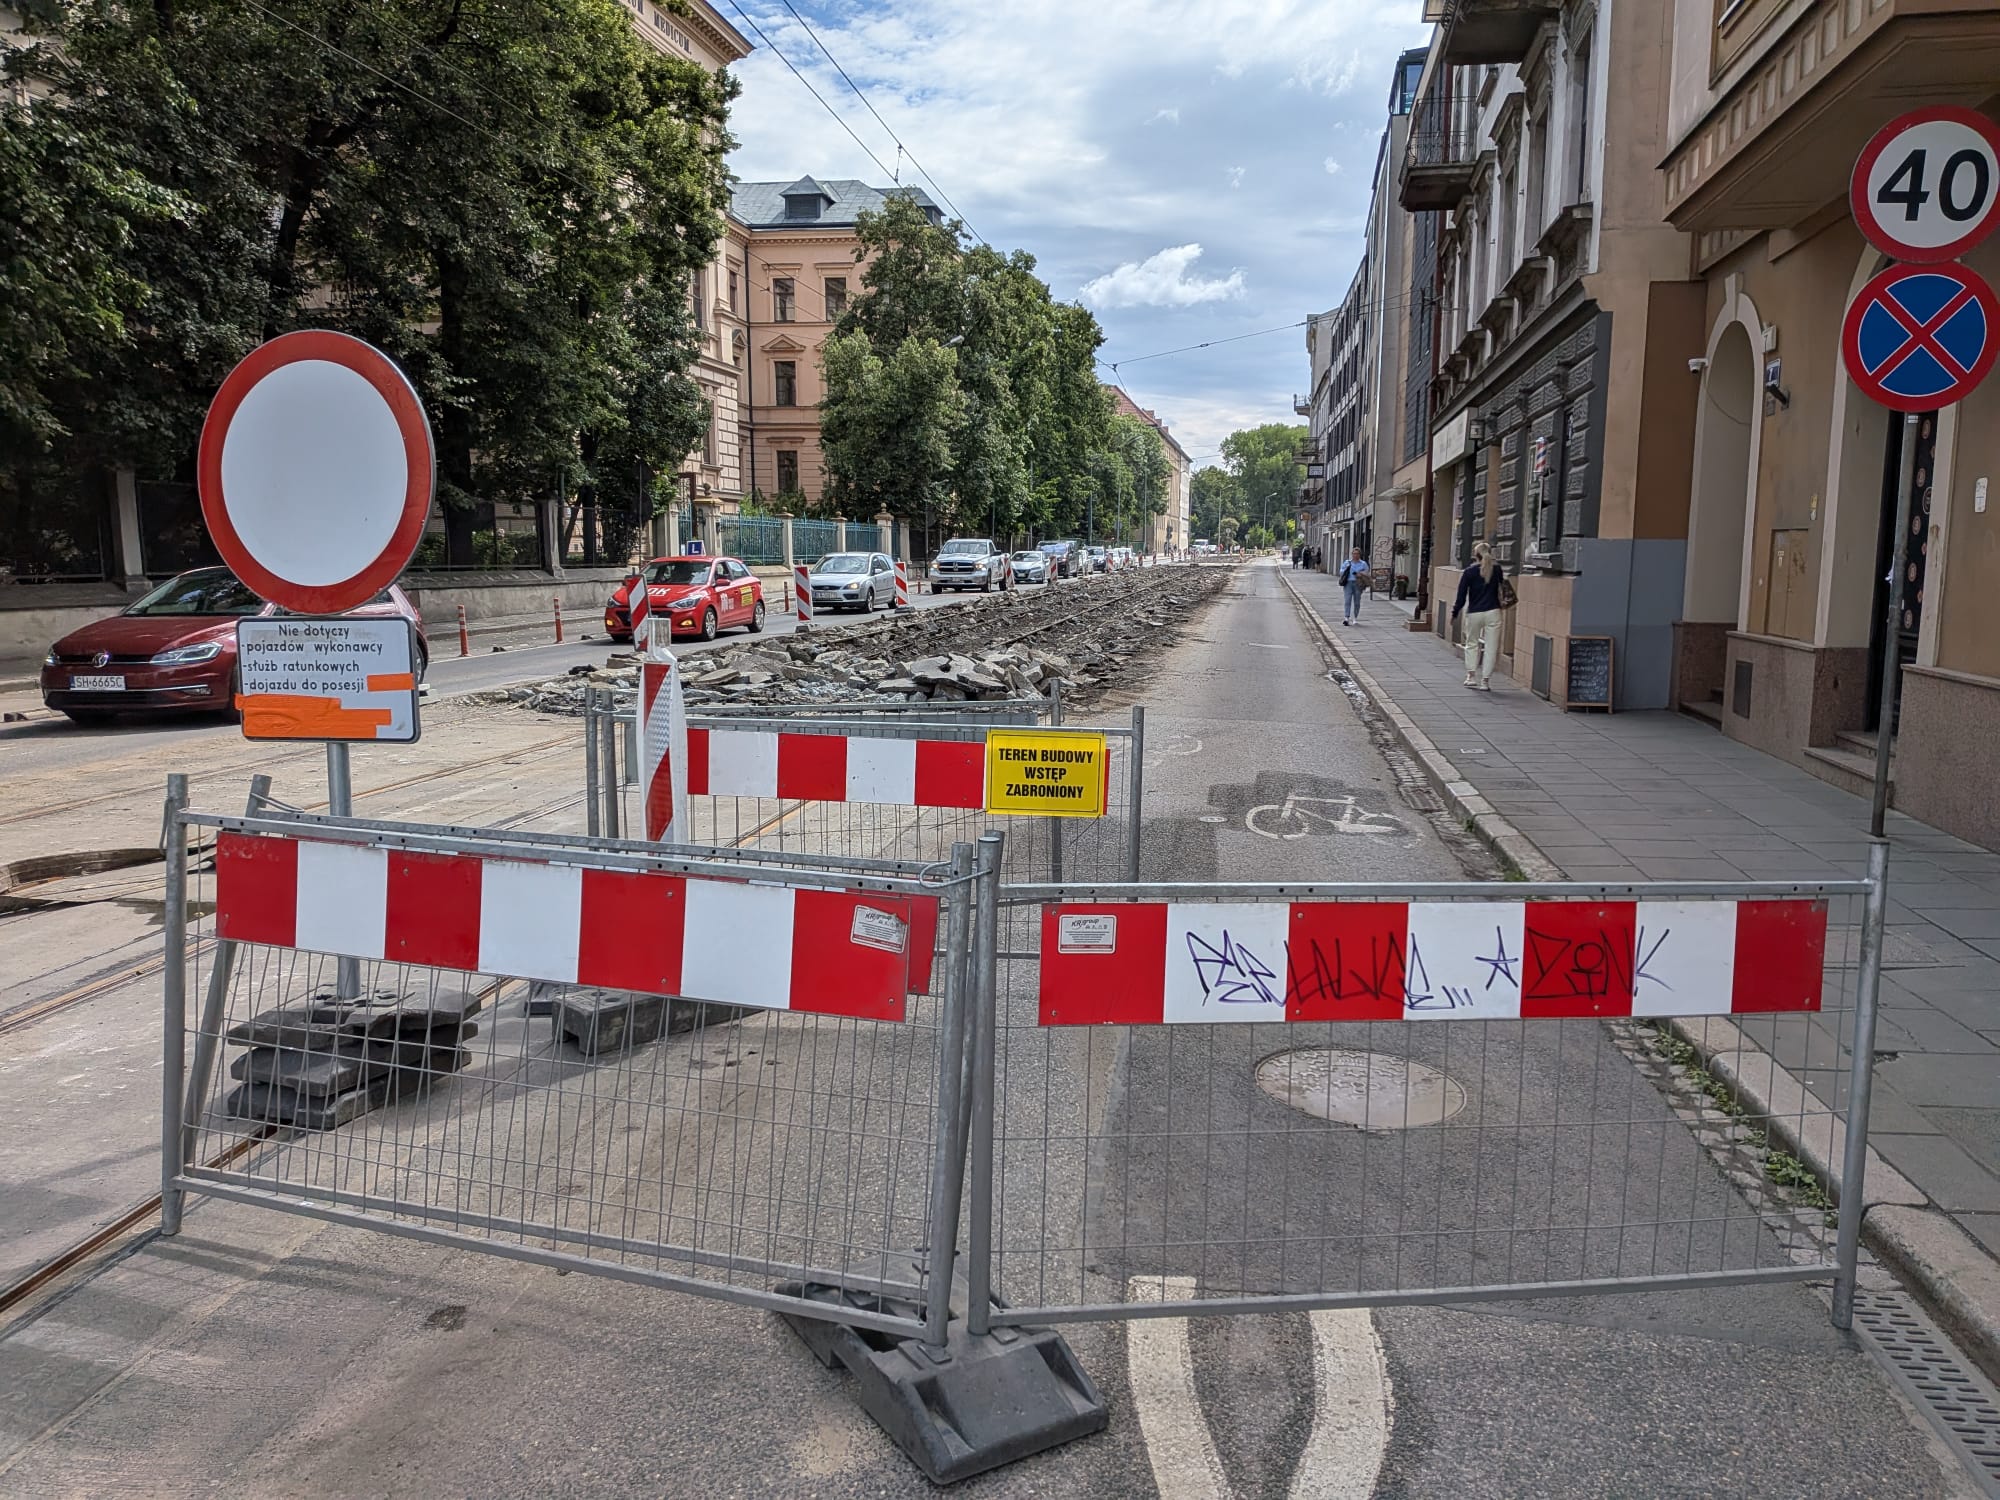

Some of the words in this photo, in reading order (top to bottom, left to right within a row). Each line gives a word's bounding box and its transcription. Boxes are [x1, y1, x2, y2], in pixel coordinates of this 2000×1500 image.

[1877, 149, 1989, 222] 40
[691, 544, 700, 554] L
[278, 624, 299, 637] Nie
[303, 624, 350, 640] dotyczy
[314, 641, 383, 656] wykonawcy
[283, 660, 360, 675] ratunkowych
[75, 677, 89, 688] SH
[92, 677, 123, 688] 6665C
[301, 678, 317, 690] do
[322, 680, 364, 693] posesji
[998, 748, 1037, 762] TEREN
[1041, 749, 1094, 764] BUDOWY
[1024, 766, 1067, 783] WSTĘP
[1005, 783, 1084, 799] ZABRONIONY
